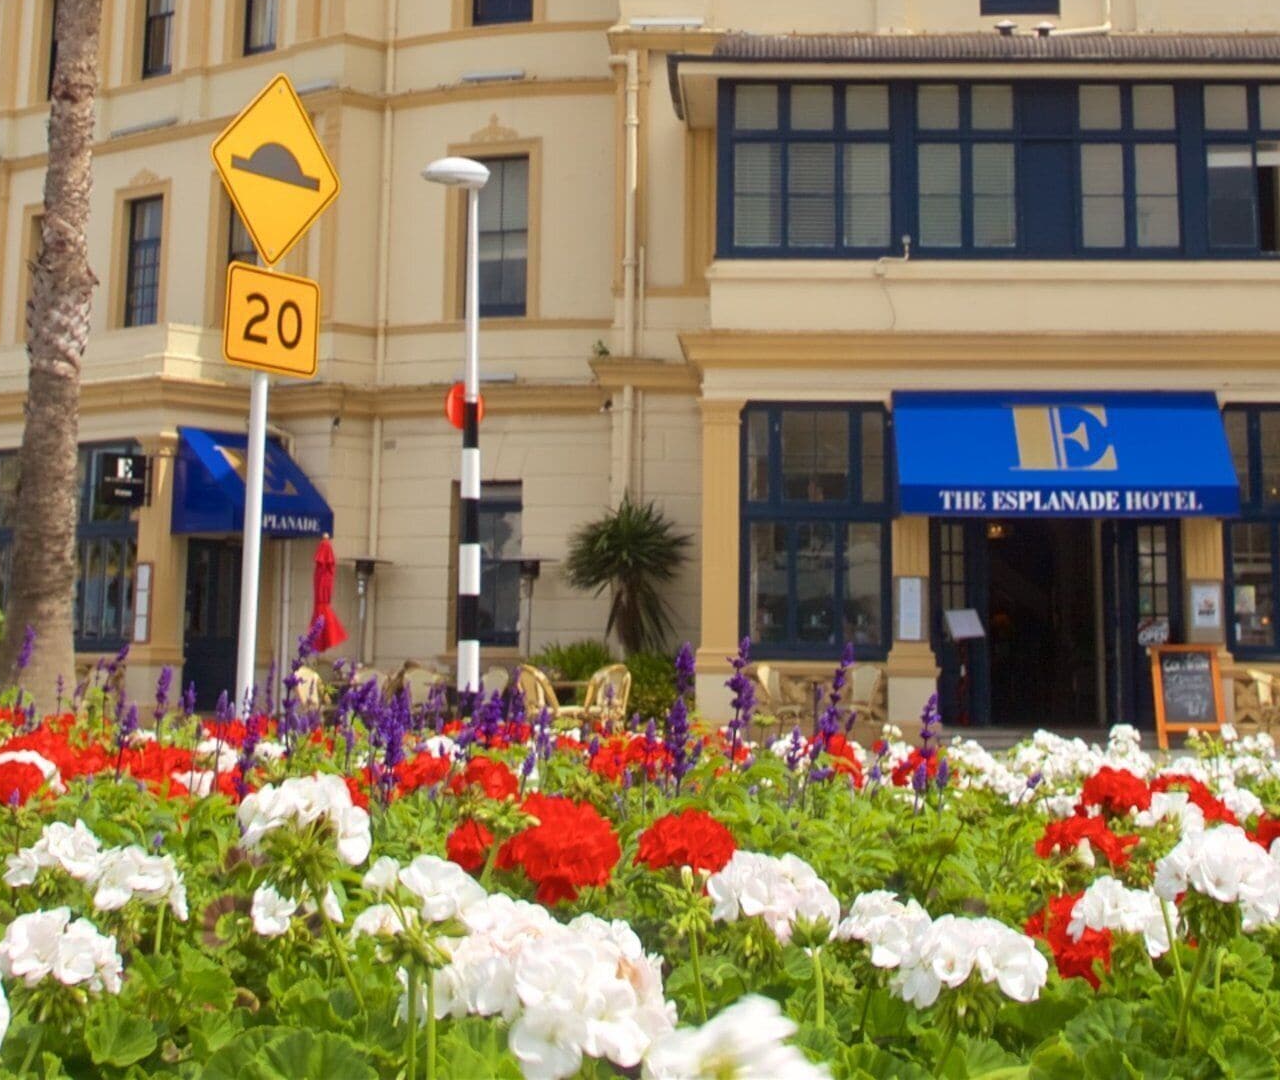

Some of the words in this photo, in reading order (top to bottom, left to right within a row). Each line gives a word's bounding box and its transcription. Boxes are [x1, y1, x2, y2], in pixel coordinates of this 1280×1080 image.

[242, 292, 302, 350] 20
[1007, 404, 1119, 471] E
[117, 457, 133, 478] E
[939, 490, 987, 511] THE
[992, 490, 1120, 512] ESPLANADE
[1125, 491, 1203, 512] HOTEL
[261, 513, 321, 532] PLANADE
